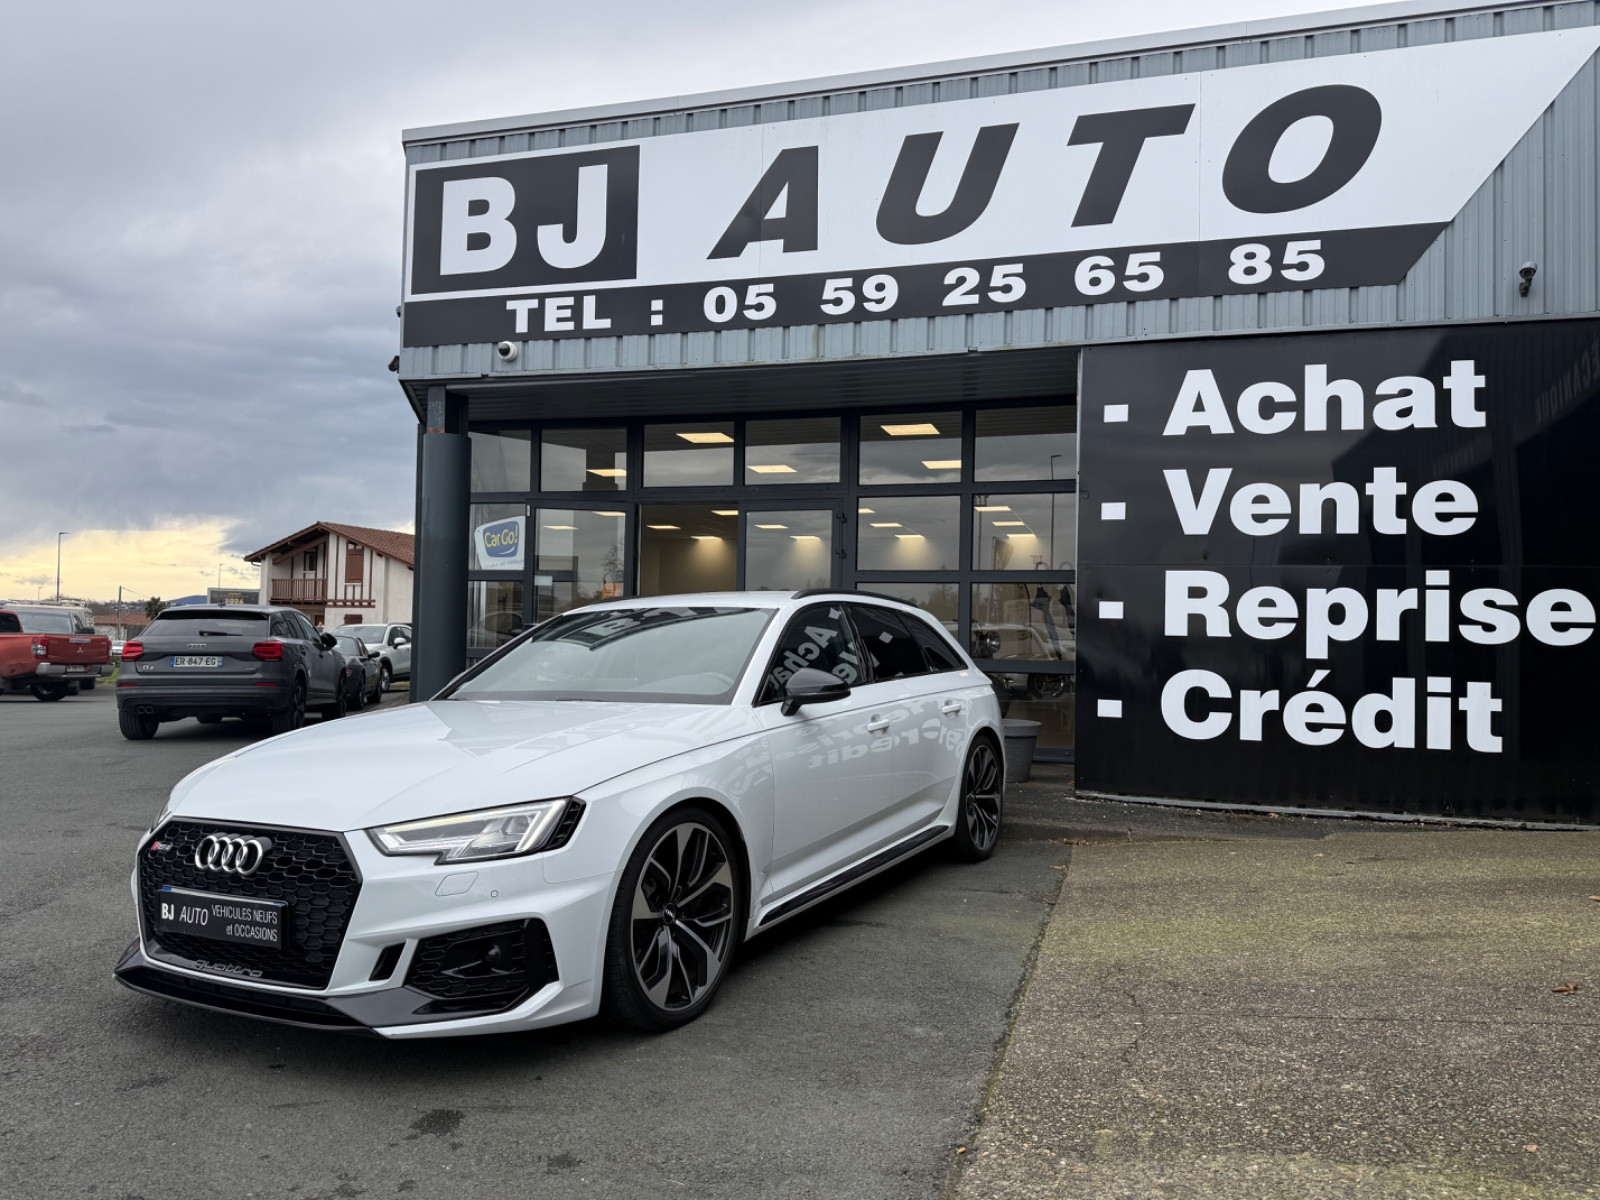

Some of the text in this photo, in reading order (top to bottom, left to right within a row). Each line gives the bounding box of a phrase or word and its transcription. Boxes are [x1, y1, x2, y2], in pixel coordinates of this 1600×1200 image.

[440, 85, 1381, 276] BJ AUTO
[506, 295, 612, 334] TEL
[704, 284, 777, 323] 05
[821, 275, 899, 316] 59
[942, 264, 1026, 307] 25
[1075, 252, 1164, 296] 65
[1229, 240, 1324, 285] 85
[1163, 360, 1486, 436] Achat
[1163, 467, 1479, 536] Vente
[1164, 571, 1596, 660] Reprise
[1161, 670, 1503, 753] Crédit
[161, 903, 209, 925] BJ AUTO
[212, 904, 278, 924] VEHICULES NEUFS
[226, 923, 278, 942] et OCCASIONS
[195, 960, 263, 978] quattro
